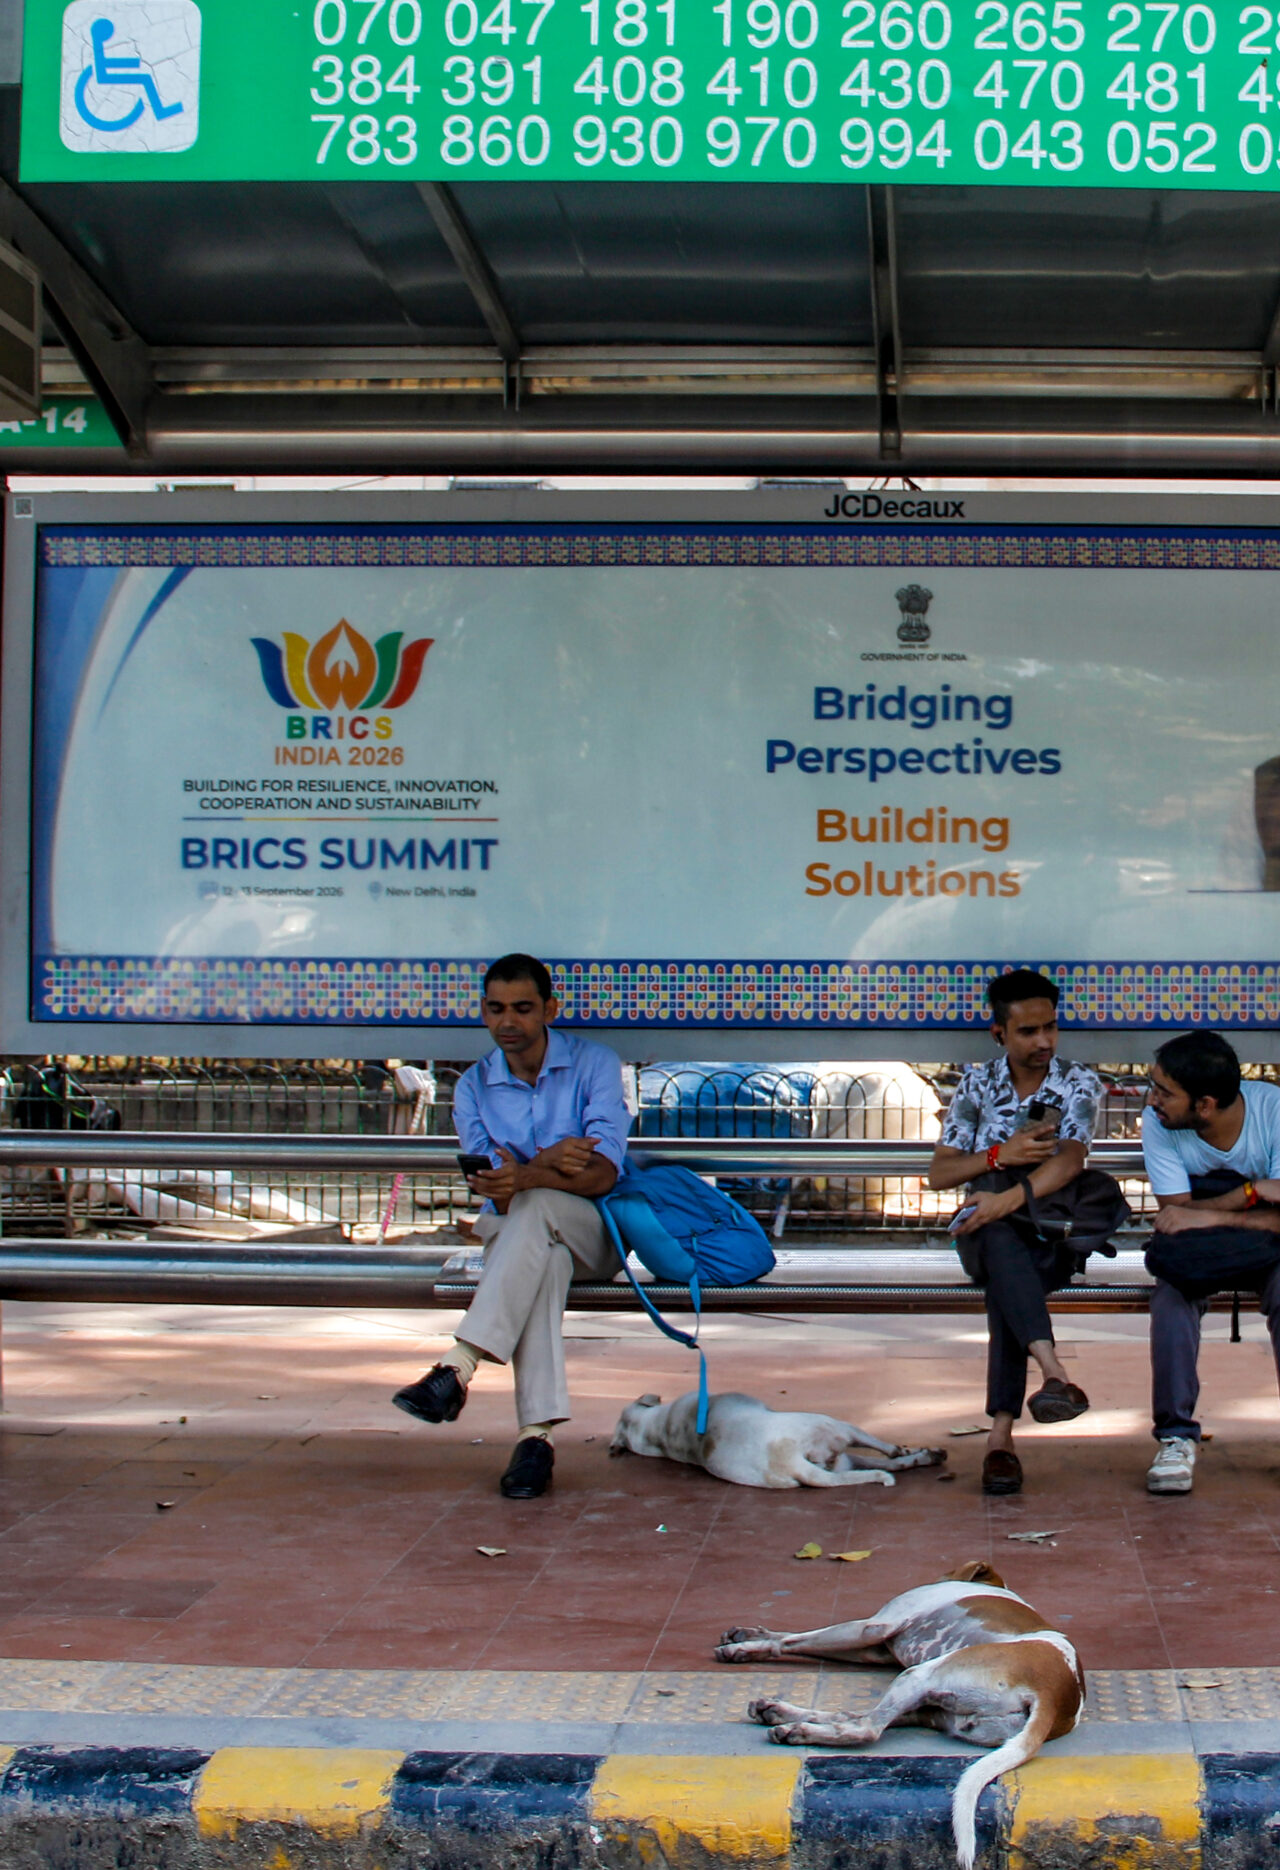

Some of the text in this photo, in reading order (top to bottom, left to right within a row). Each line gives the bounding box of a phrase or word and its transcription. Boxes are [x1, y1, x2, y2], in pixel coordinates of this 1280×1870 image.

[314, 0, 421, 46] 070
[445, 0, 555, 46] 047
[581, 0, 675, 46] 181
[713, 0, 818, 48] 190
[841, 0, 951, 50] 260
[975, 1, 1085, 51] 265
[1107, 3, 1216, 54] 270
[311, 54, 420, 104] 384
[442, 55, 541, 105] 391
[574, 56, 684, 106] 408
[707, 57, 817, 108] 410
[840, 59, 951, 109] 430
[974, 60, 1084, 110] 470
[1107, 62, 1205, 112] 481
[311, 114, 417, 165] 783
[440, 115, 550, 165] 860
[573, 115, 683, 166] 930
[707, 116, 816, 167] 970
[840, 117, 952, 168] 994
[975, 119, 1083, 170] 043
[1108, 121, 1217, 172] 052
[824, 494, 965, 517] JCDecaux
[860, 653, 968, 661] GOVERNMENT OF INDIA
[813, 683, 1013, 730] Bridging
[286, 715, 393, 739] BRICS
[275, 747, 405, 766] INDIA 2026
[766, 737, 1062, 783] Perspectives
[183, 780, 499, 794] BUILDING FOR RESILIENCE, INNOVATION,
[199, 798, 480, 810] COOPERATION AND SUSTAINABILITY
[816, 806, 1010, 852] Building
[180, 838, 499, 871] BRICS SUMMIT
[253, 886, 314, 898] September
[317, 887, 344, 897] 2026
[386, 886, 477, 898] New Delhi, India
[805, 860, 1021, 898] Solutions
